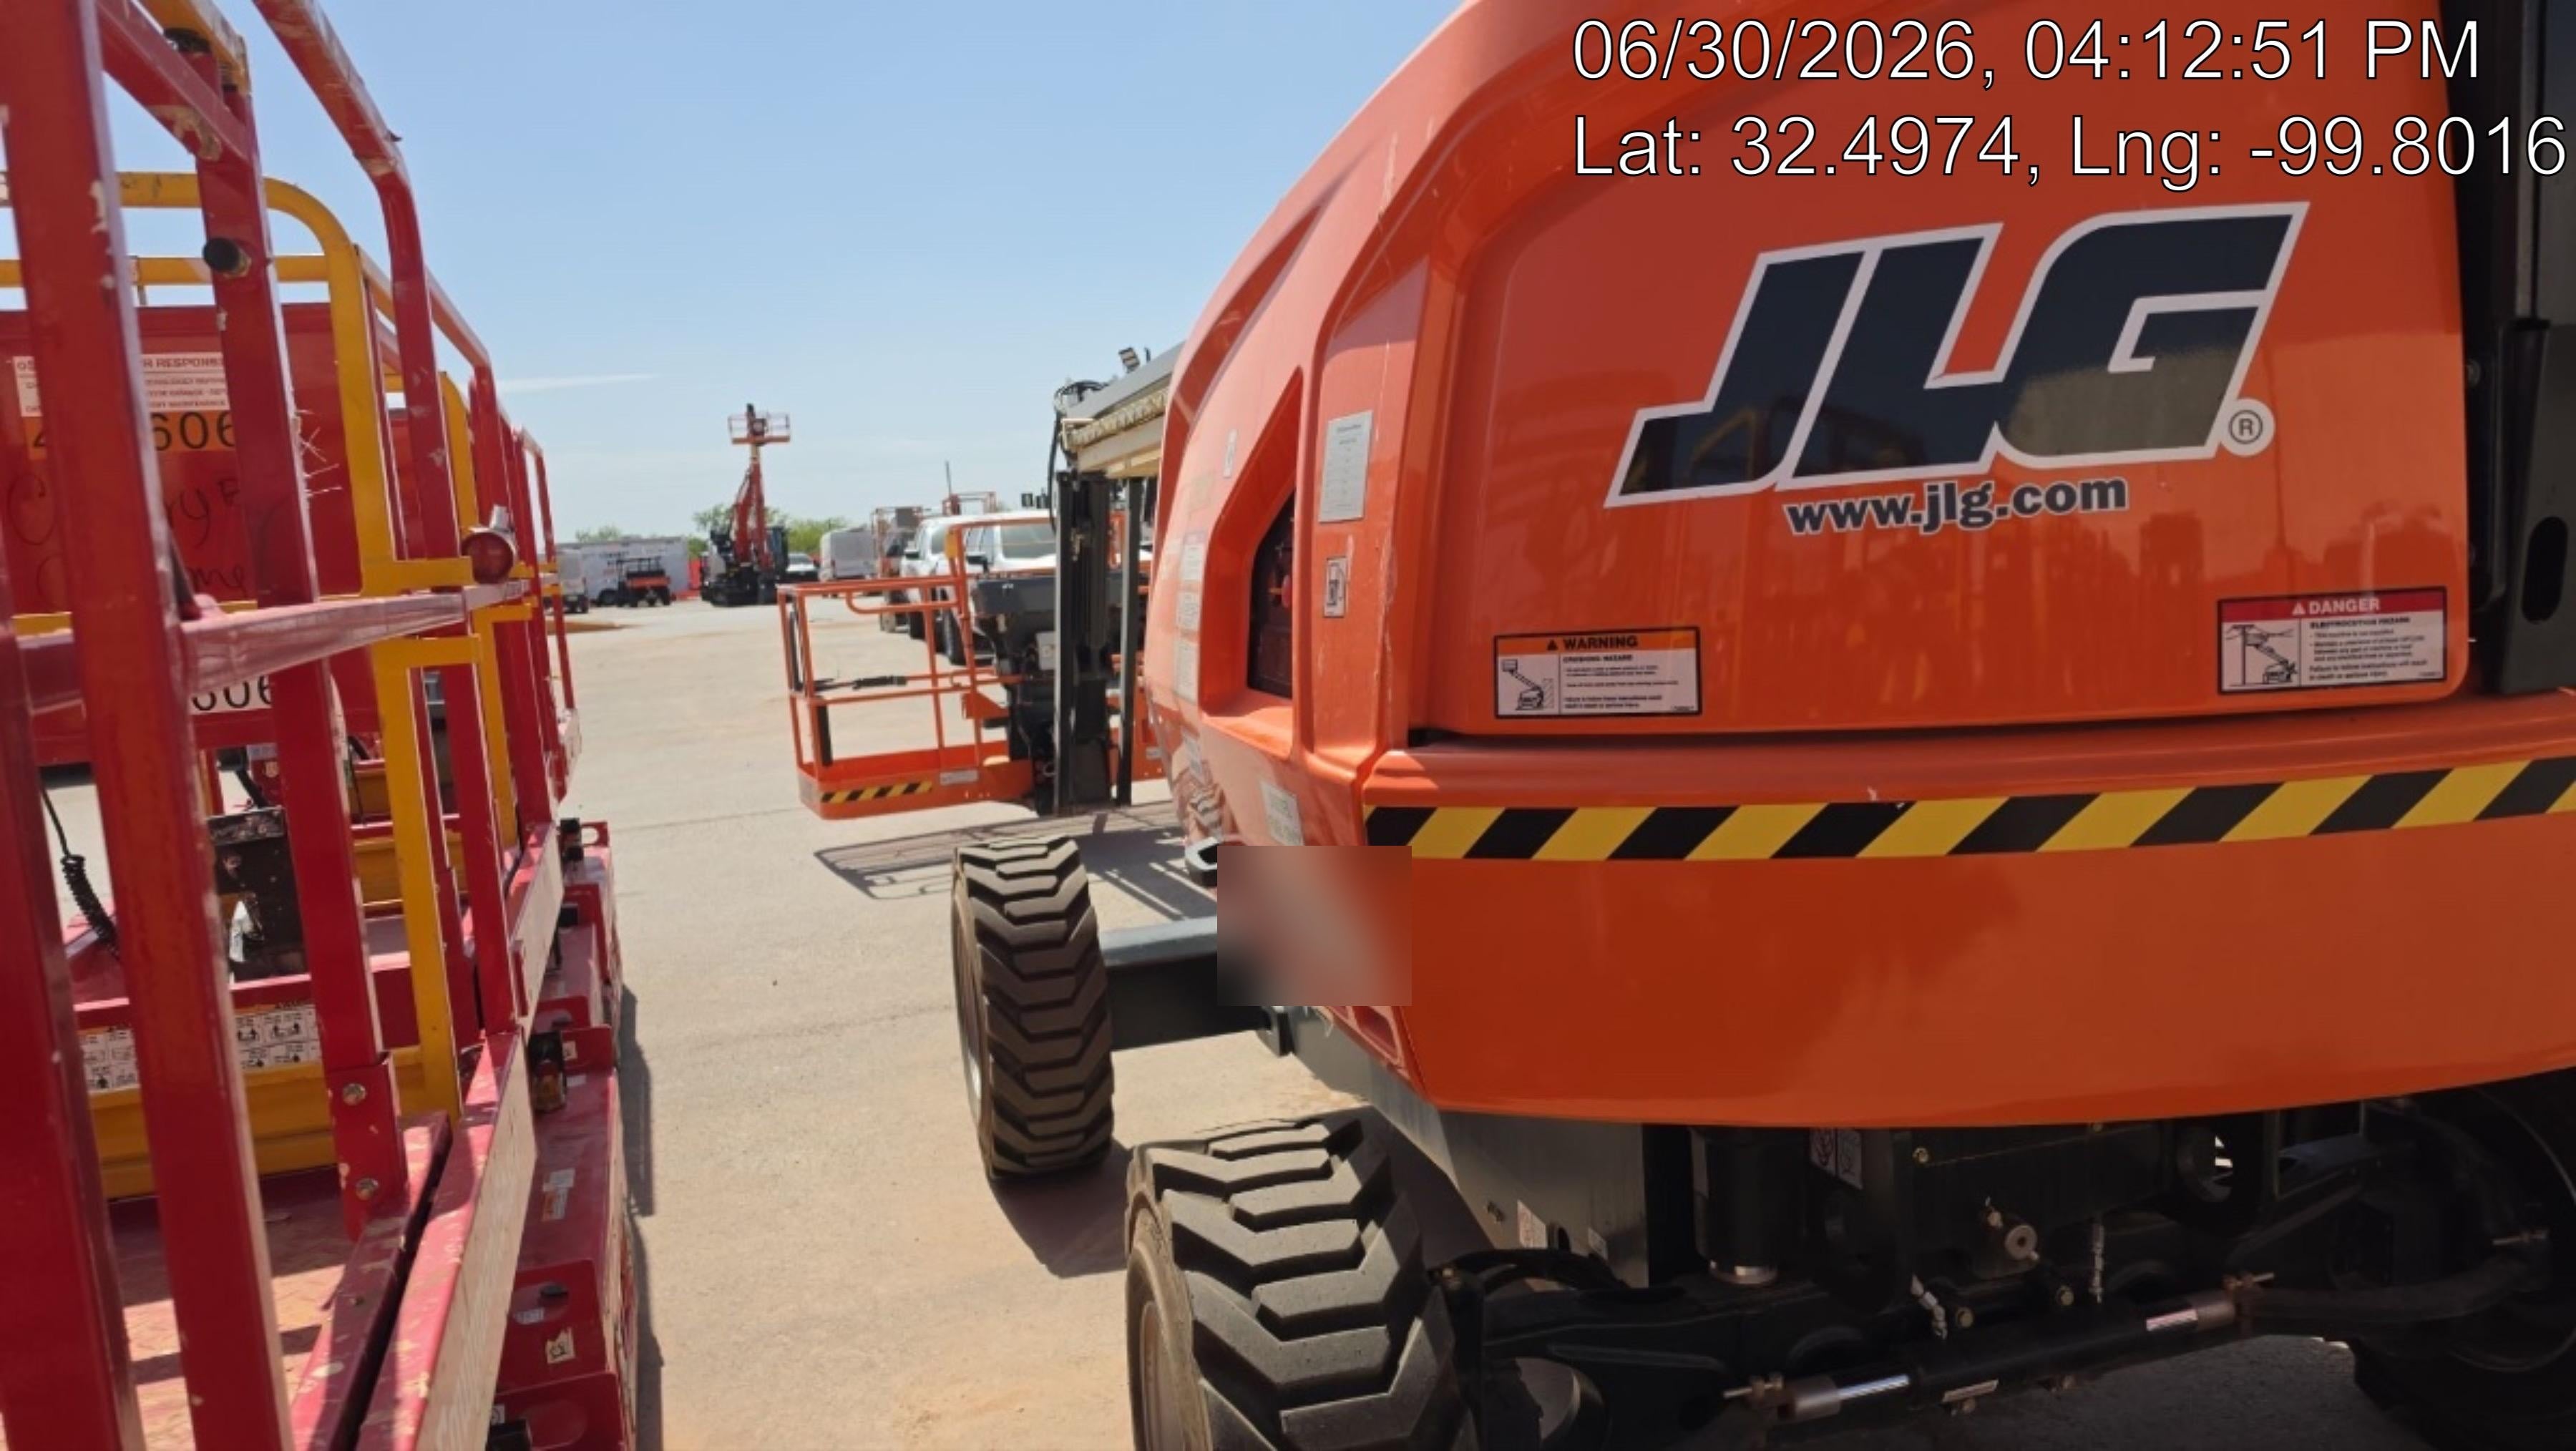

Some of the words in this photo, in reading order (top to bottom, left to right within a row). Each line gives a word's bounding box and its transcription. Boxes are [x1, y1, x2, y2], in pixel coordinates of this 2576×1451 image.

[1604, 202, 2309, 508] JLG
[1786, 478, 2128, 534] www.jlg.com
[2309, 597, 2381, 615] DANGER
[1563, 635, 1639, 650] WARNING
